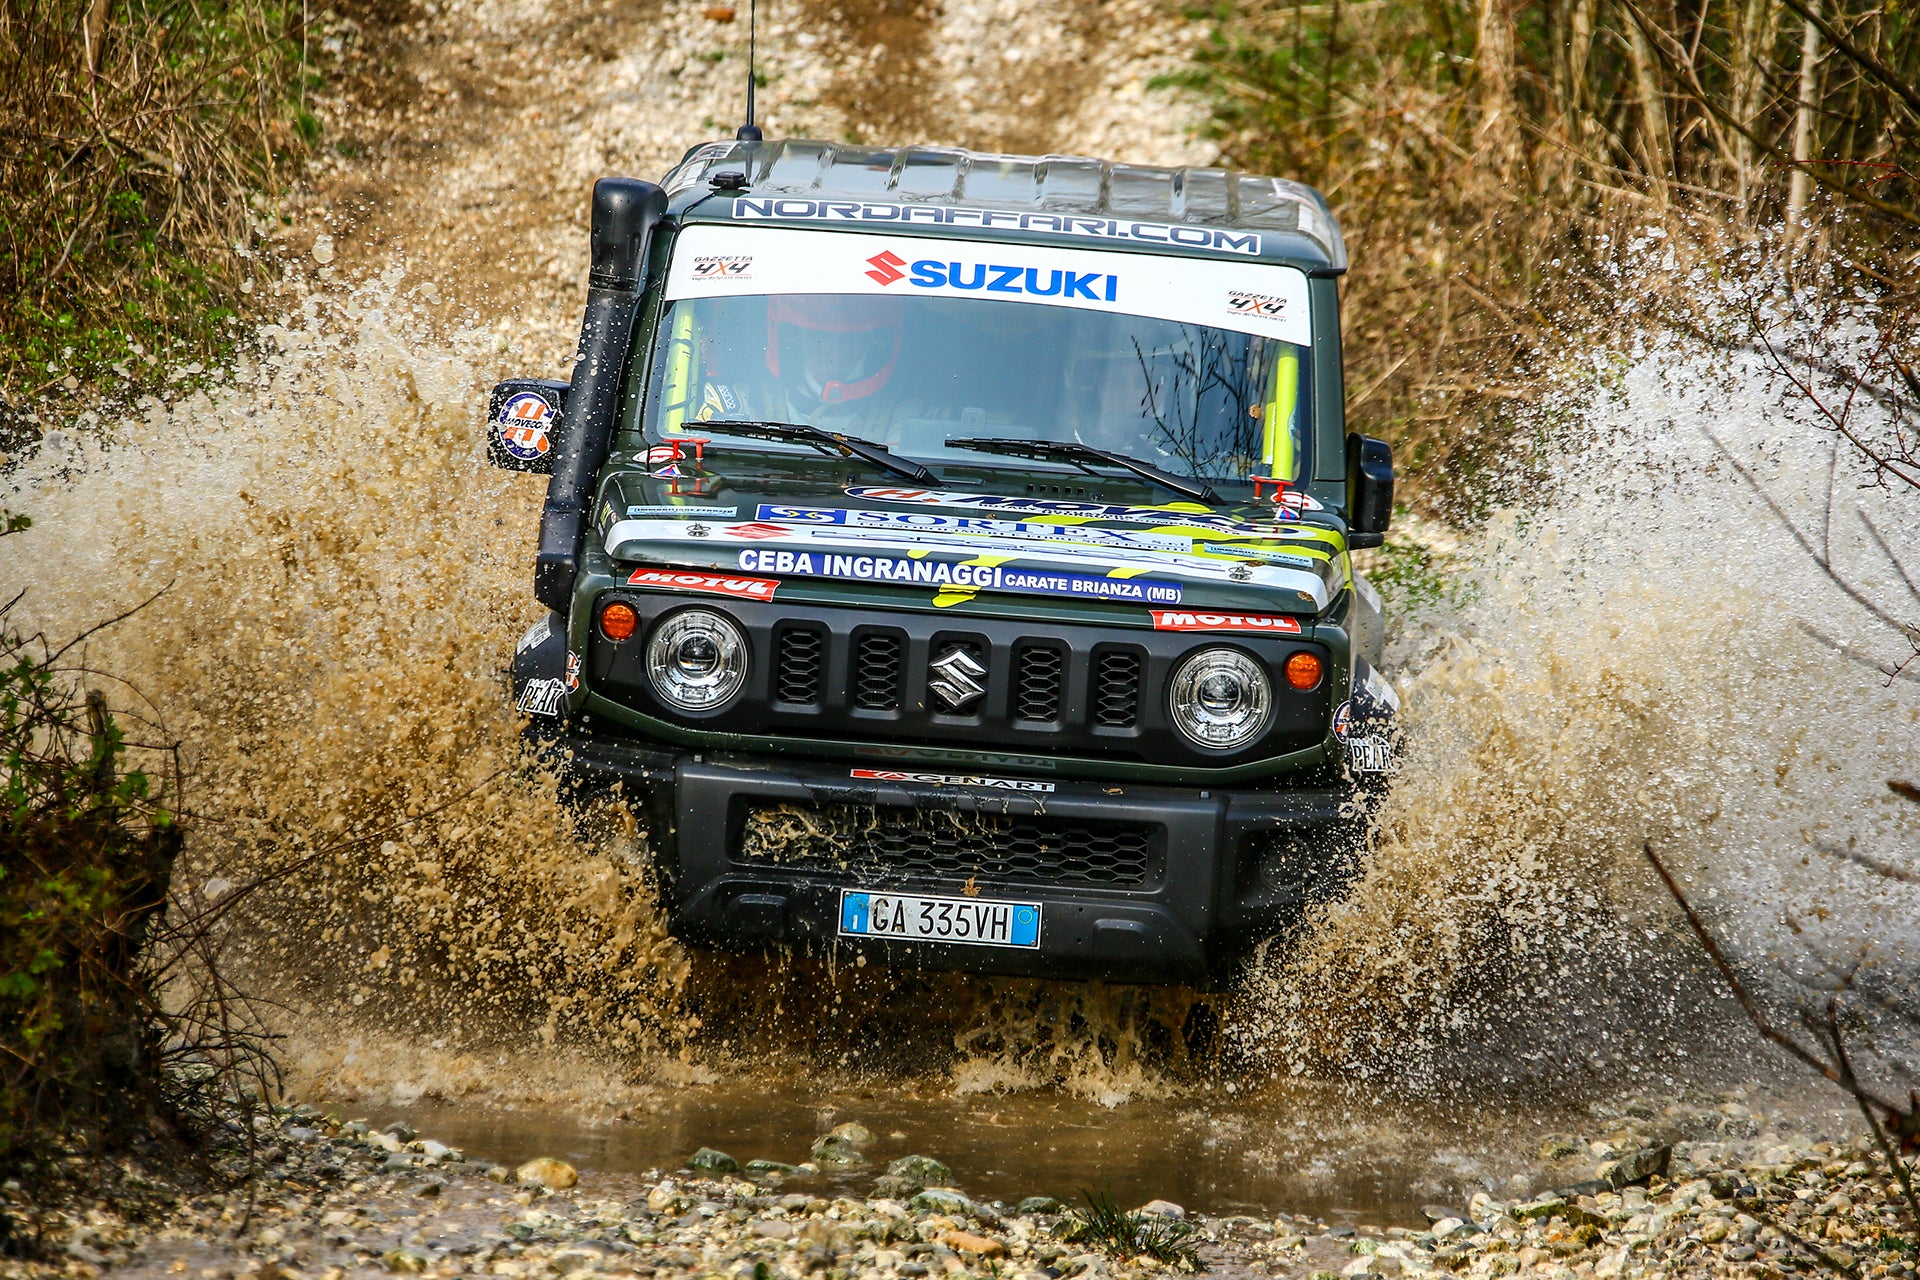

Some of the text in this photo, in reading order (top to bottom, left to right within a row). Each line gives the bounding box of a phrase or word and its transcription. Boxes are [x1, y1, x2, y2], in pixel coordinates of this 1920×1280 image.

[735, 199, 1258, 253] NORDAFFARI.COM
[908, 259, 1118, 302] SUZUKI
[1228, 290, 1287, 303] GAZZETTA
[857, 512, 1137, 541] SORTEX
[634, 572, 771, 595] MOTUL
[738, 549, 1182, 604] CEBA INGRANAGGI CARATE BRIANZA (MB)
[1161, 611, 1293, 628] MOTUL
[517, 680, 564, 714] PEAK
[913, 774, 1053, 791] GENART
[872, 898, 907, 934] GA
[918, 901, 1009, 940] 335VH
